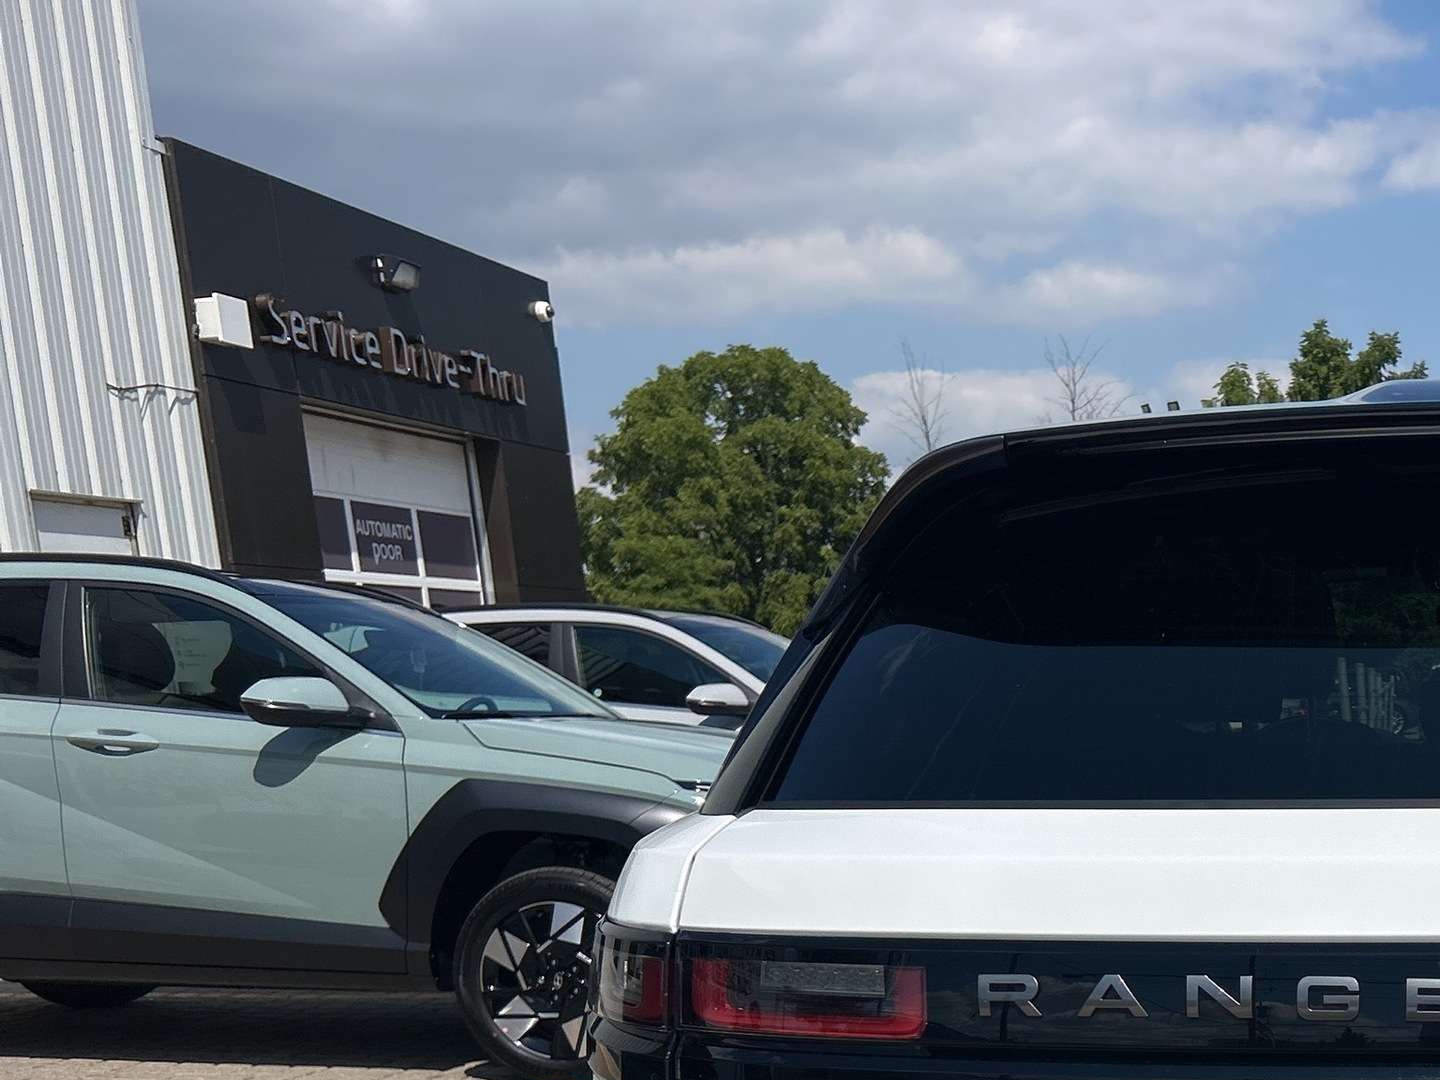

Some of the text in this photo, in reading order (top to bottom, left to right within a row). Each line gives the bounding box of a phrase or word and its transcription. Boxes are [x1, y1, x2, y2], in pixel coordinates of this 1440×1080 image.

[257, 294, 527, 406] Service Drive-Thru
[355, 518, 413, 541] AUTOMATIC
